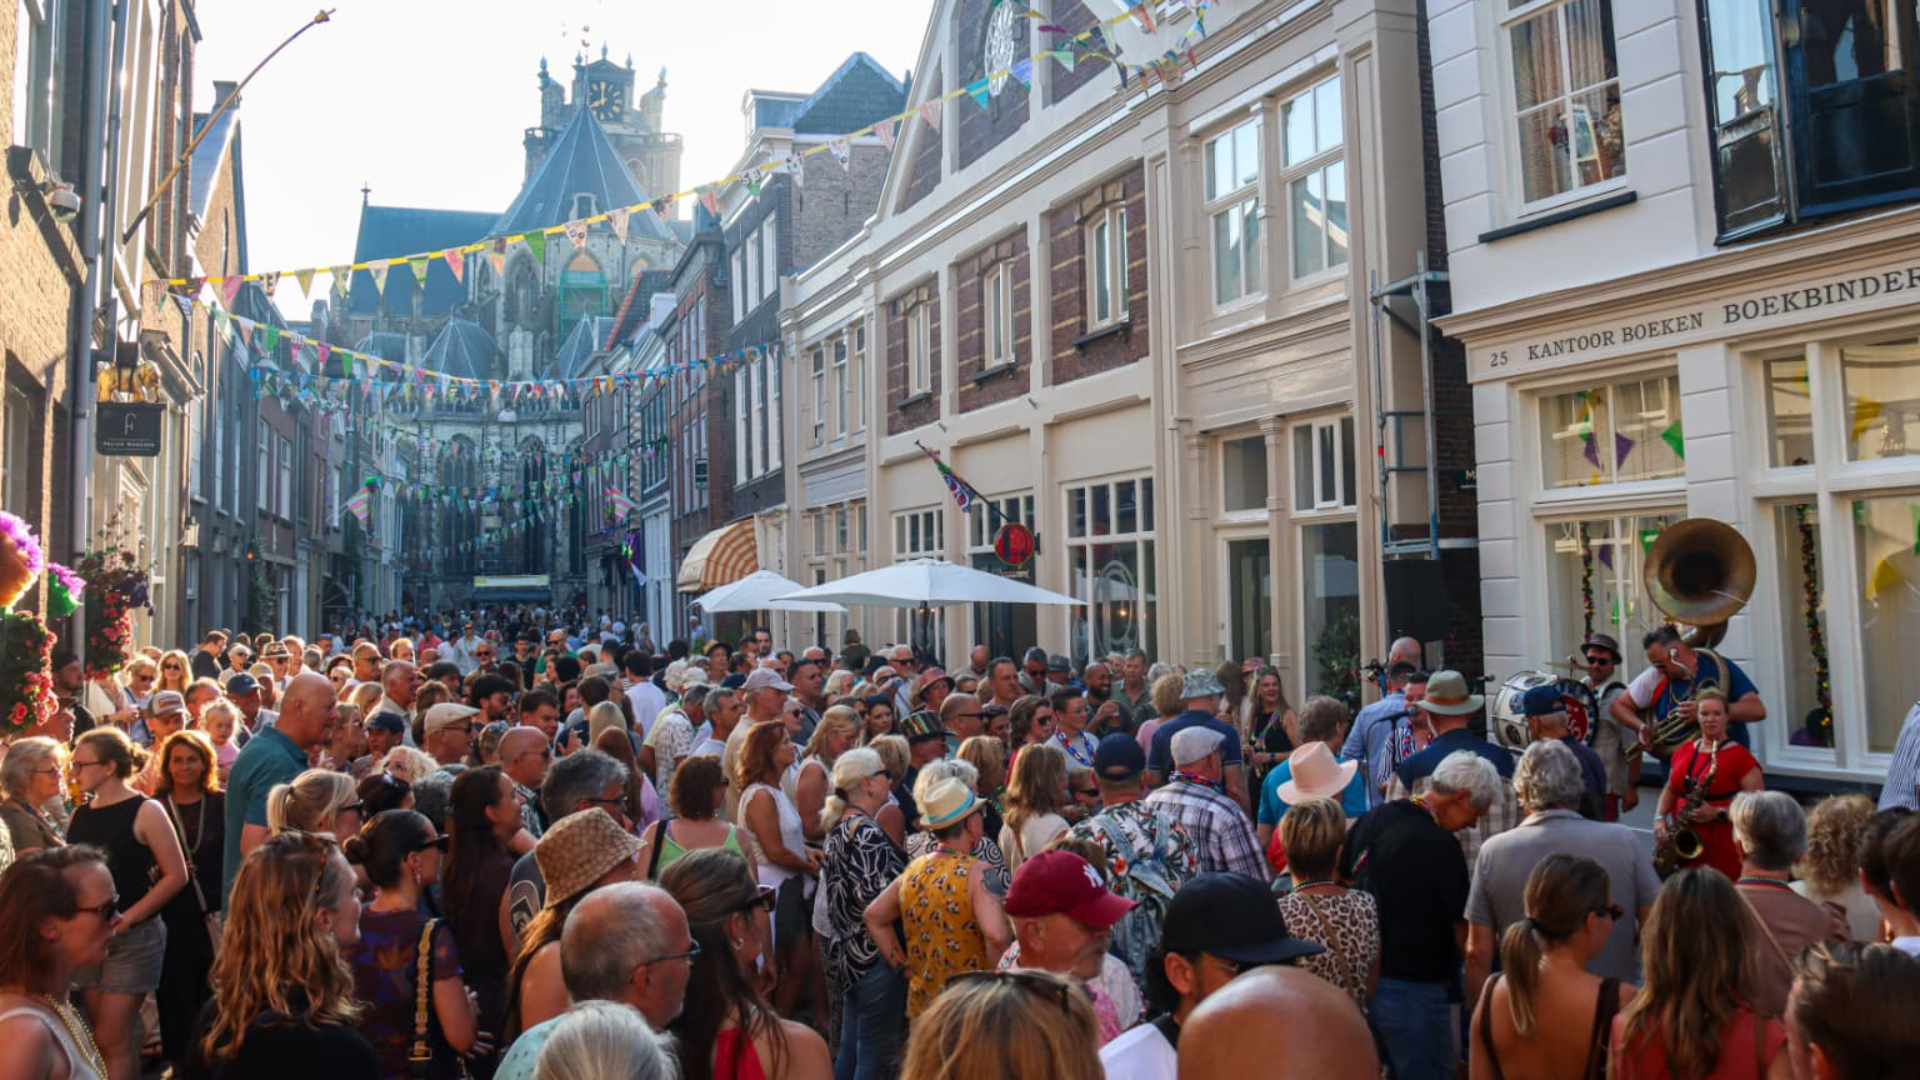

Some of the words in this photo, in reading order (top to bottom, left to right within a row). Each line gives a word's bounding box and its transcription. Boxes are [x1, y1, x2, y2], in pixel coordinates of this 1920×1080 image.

[1489, 350, 1509, 368] 25
[1527, 330, 1616, 361] KANTOOR
[1621, 312, 1704, 343] BOEKEN
